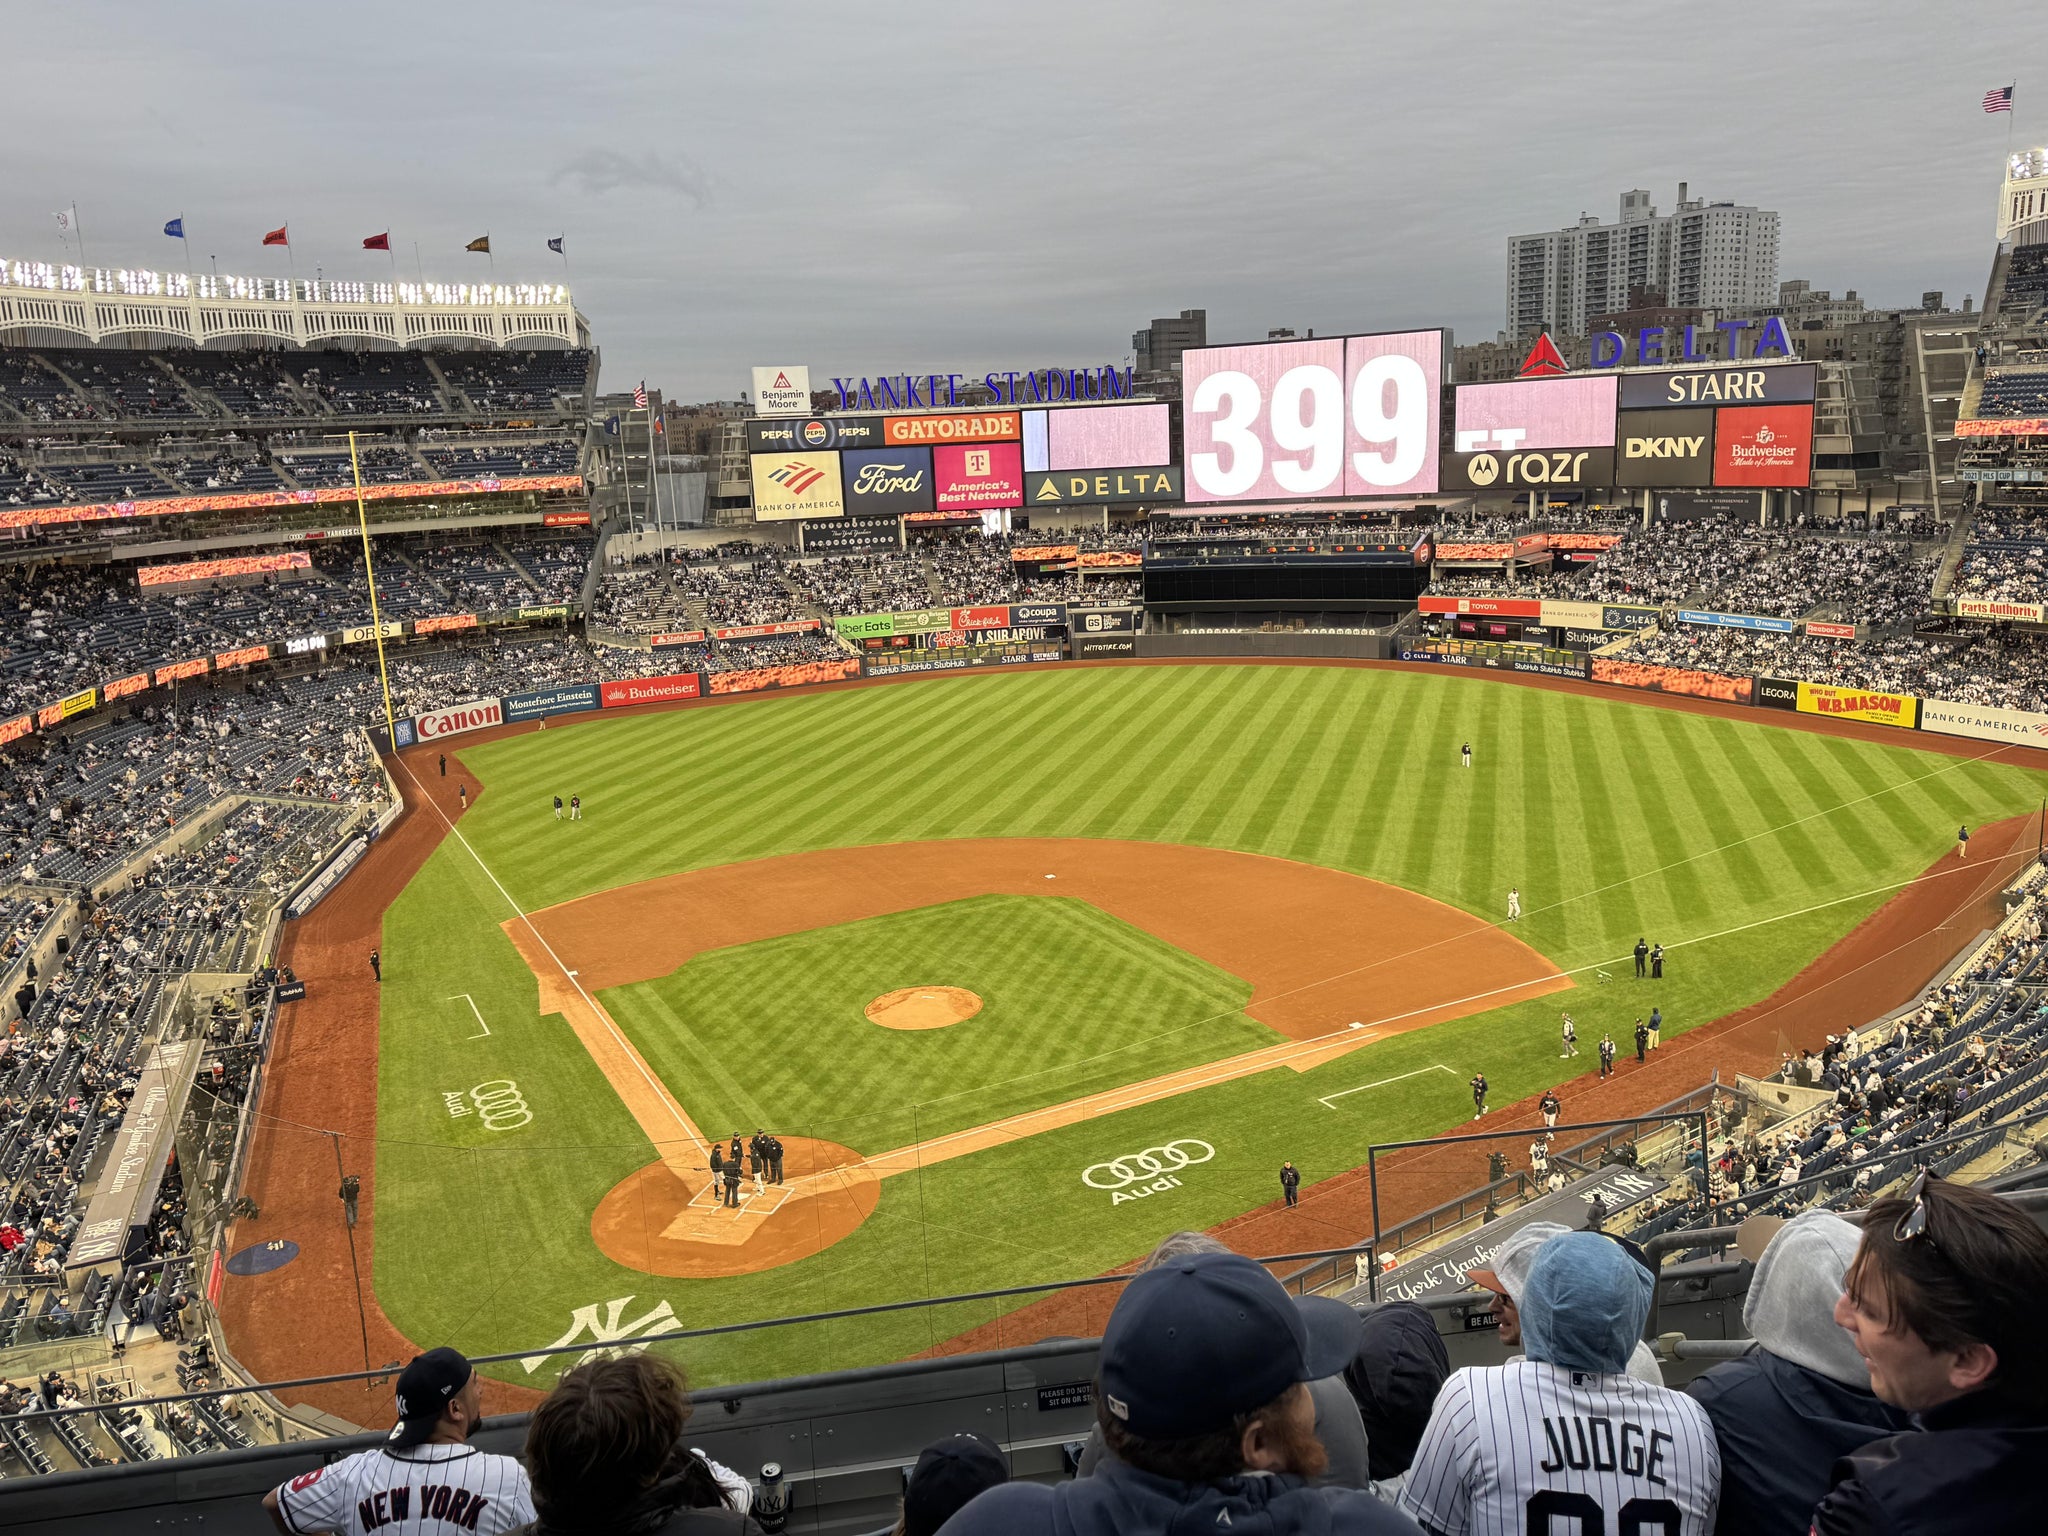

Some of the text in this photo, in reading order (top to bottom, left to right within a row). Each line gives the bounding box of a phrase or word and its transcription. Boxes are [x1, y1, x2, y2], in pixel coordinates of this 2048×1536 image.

[1591, 316, 1796, 368] DELTA
[830, 365, 1135, 411] YANKEE STADIUM
[1667, 371, 1766, 402] STARR
[762, 390, 804, 401] Benjamin
[768, 399, 798, 409] Moore
[892, 416, 1015, 441] GATORADE
[1191, 354, 1429, 496] 399
[761, 430, 793, 440] PEPSI
[838, 427, 870, 437] PEPSI
[1626, 436, 1705, 458] DKNY
[1731, 444, 1797, 457] Budweiser
[1507, 452, 1588, 484] razr
[853, 463, 924, 495] Ford
[1964, 471, 1977, 479] 2021
[948, 480, 1010, 492] America's
[1070, 473, 1173, 497] DELTA
[939, 489, 1020, 503] Best Network
[757, 501, 841, 512] BANK OF AMERICA
[326, 528, 353, 537] YANKEES
[518, 606, 567, 619] Poland Spring
[1031, 607, 1057, 618] coupa
[1961, 603, 2038, 618] Parts Authority
[1088, 618, 1100, 627] GS
[1625, 614, 1657, 625] CLEAR
[1916, 618, 1944, 631] LEGORA
[353, 625, 390, 641] ORS
[837, 622, 862, 634] Uber
[865, 621, 891, 632] Eats
[1807, 624, 1836, 634] Reebok
[309, 635, 326, 650] PM
[976, 630, 984, 645] A
[1566, 631, 1608, 645] StubHub
[1083, 642, 1133, 652] NITTOTIRE.COM
[934, 658, 965, 669] StubHub
[1002, 654, 1027, 664] STARR
[1441, 654, 1467, 665] STARR
[869, 665, 899, 677] StubHub
[901, 662, 932, 673] StubHub
[1514, 662, 1539, 672] StubHub
[1540, 665, 1563, 675] StubHub
[1563, 668, 1586, 678] StubHub
[629, 683, 693, 700] Budweiser
[1761, 687, 1796, 701] LEGORA
[1809, 688, 1823, 696] WHO
[509, 690, 592, 710] Montefiore Einstein
[397, 723, 409, 731] NEW
[418, 704, 500, 737] Canon
[1925, 711, 2029, 734] BANK OF AMERICA
[399, 735, 411, 743] LIFE
[280, 987, 303, 997] StubHub
[137, 1085, 168, 1117] Welcome
[442, 1091, 473, 1118] Audi
[121, 1122, 157, 1154] Yankee
[108, 1155, 145, 1195] Stadium
[1111, 1174, 1183, 1206] Audi
[1386, 1245, 1505, 1301] York Yankee
[1471, 1315, 1498, 1327] BE ALE
[1040, 1385, 1091, 1399] PLEASE DO NOT
[1049, 1398, 1060, 1406] SIT
[1061, 1397, 1071, 1405] ON
[1541, 1416, 1673, 1487] JUDGE
[358, 1484, 489, 1534] NEW YORK
